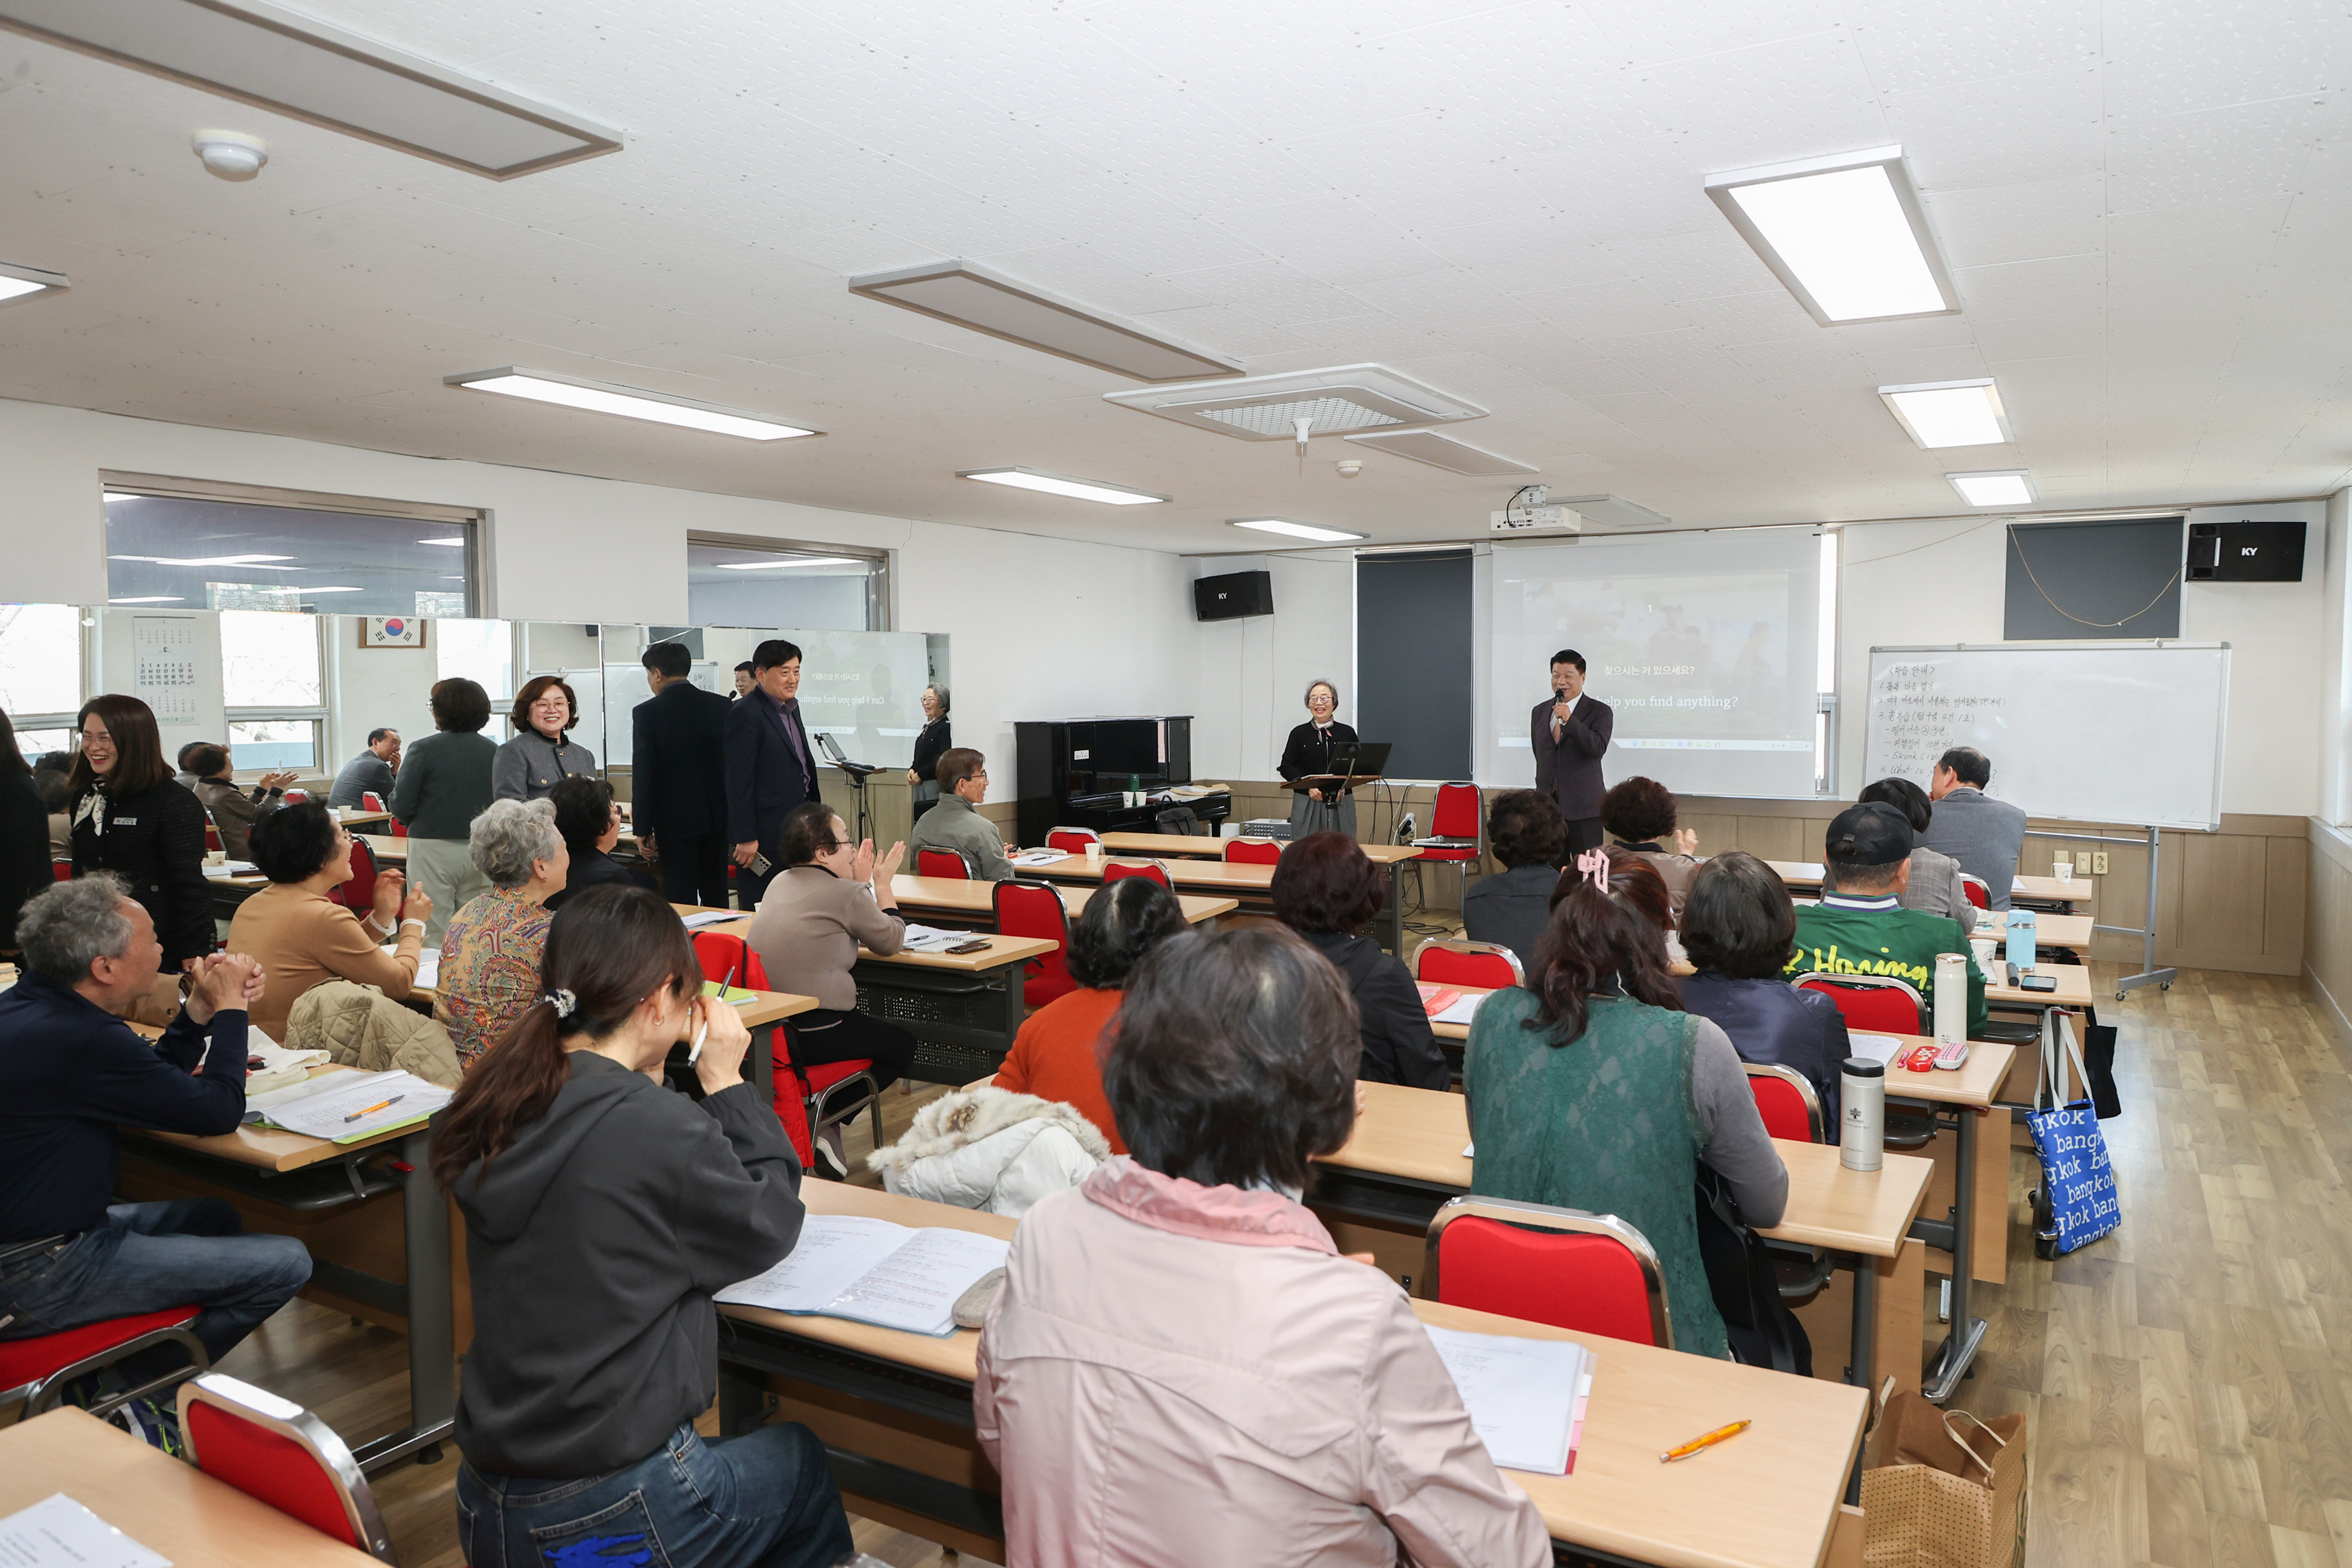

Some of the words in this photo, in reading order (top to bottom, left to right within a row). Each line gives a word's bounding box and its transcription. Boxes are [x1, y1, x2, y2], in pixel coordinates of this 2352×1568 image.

[2241, 547, 2259, 556] KY
[1218, 592, 1228, 600] KY
[1647, 604, 1652, 612] 1
[1604, 665, 1640, 676] 찾으시는
[1642, 665, 1651, 676] 거
[1653, 665, 1696, 676] 있으세요?
[1624, 698, 1646, 710] you
[1649, 695, 1674, 707] find
[1676, 696, 1739, 710] anything?
[1814, 945, 1928, 990] Haring
[2027, 1110, 2085, 1137] gkok
